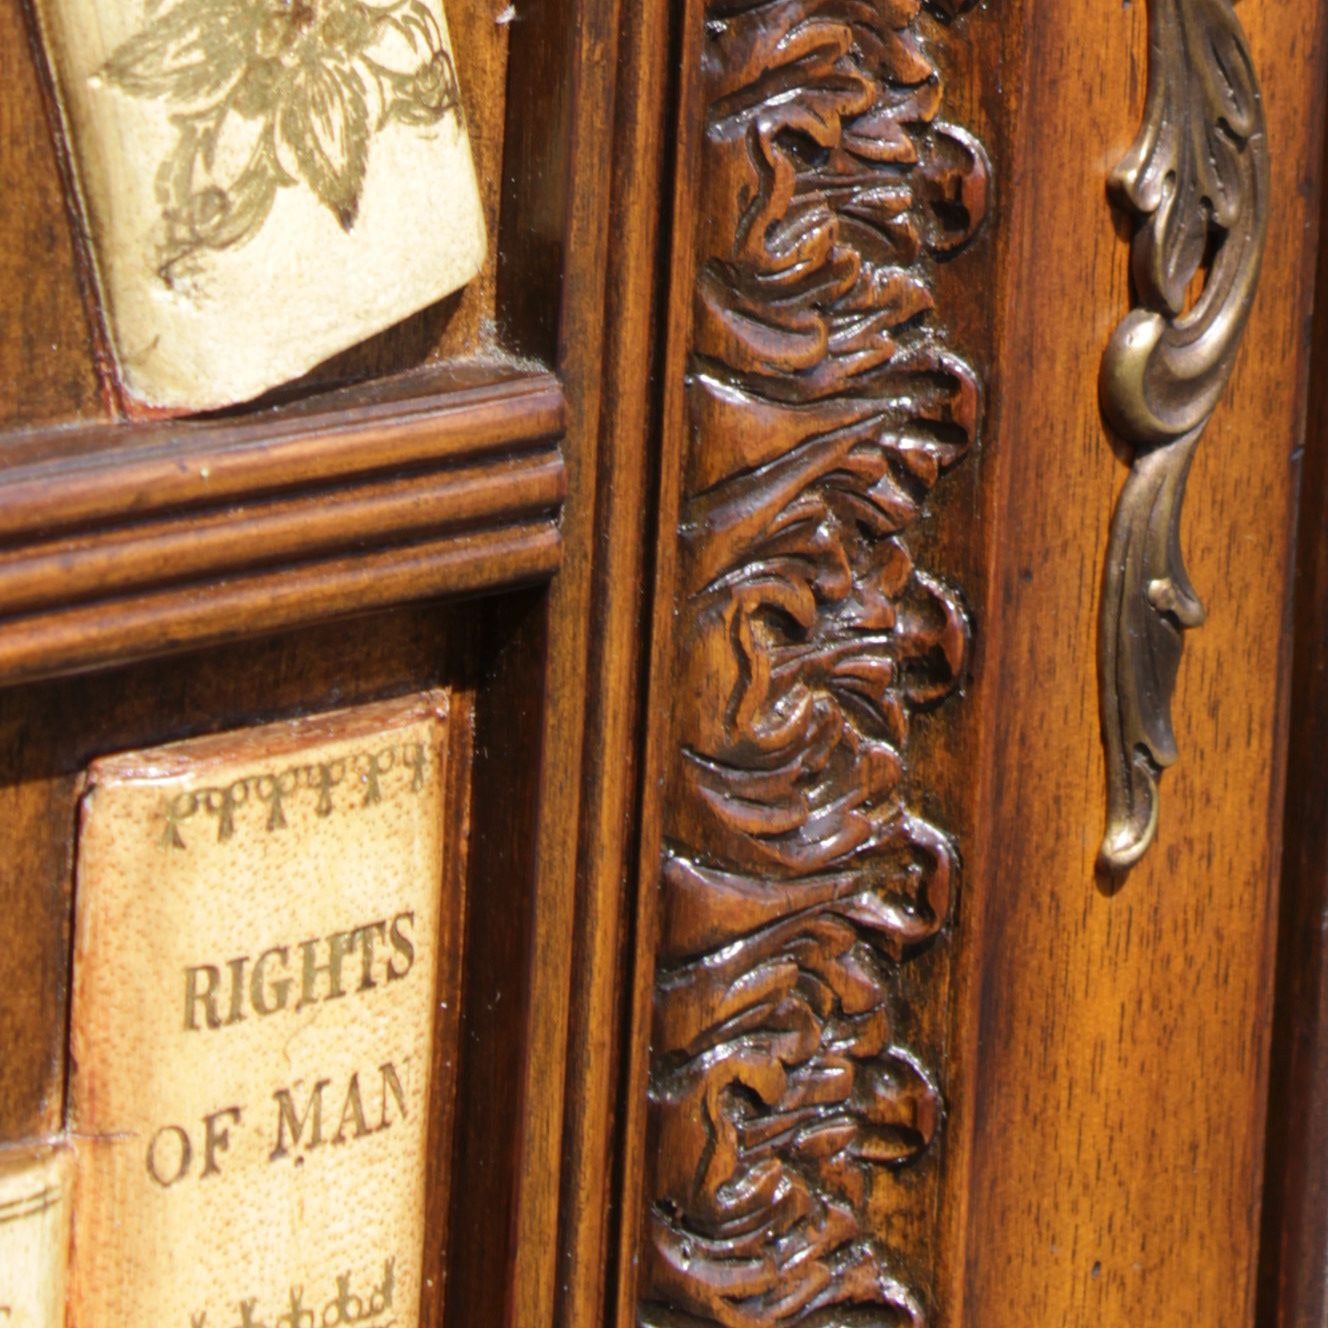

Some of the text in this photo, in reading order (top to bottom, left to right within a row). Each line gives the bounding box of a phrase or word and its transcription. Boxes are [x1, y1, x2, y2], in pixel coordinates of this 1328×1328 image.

[184, 910, 416, 1032] RIGHTS
[146, 1056, 412, 1187] OF MAN
